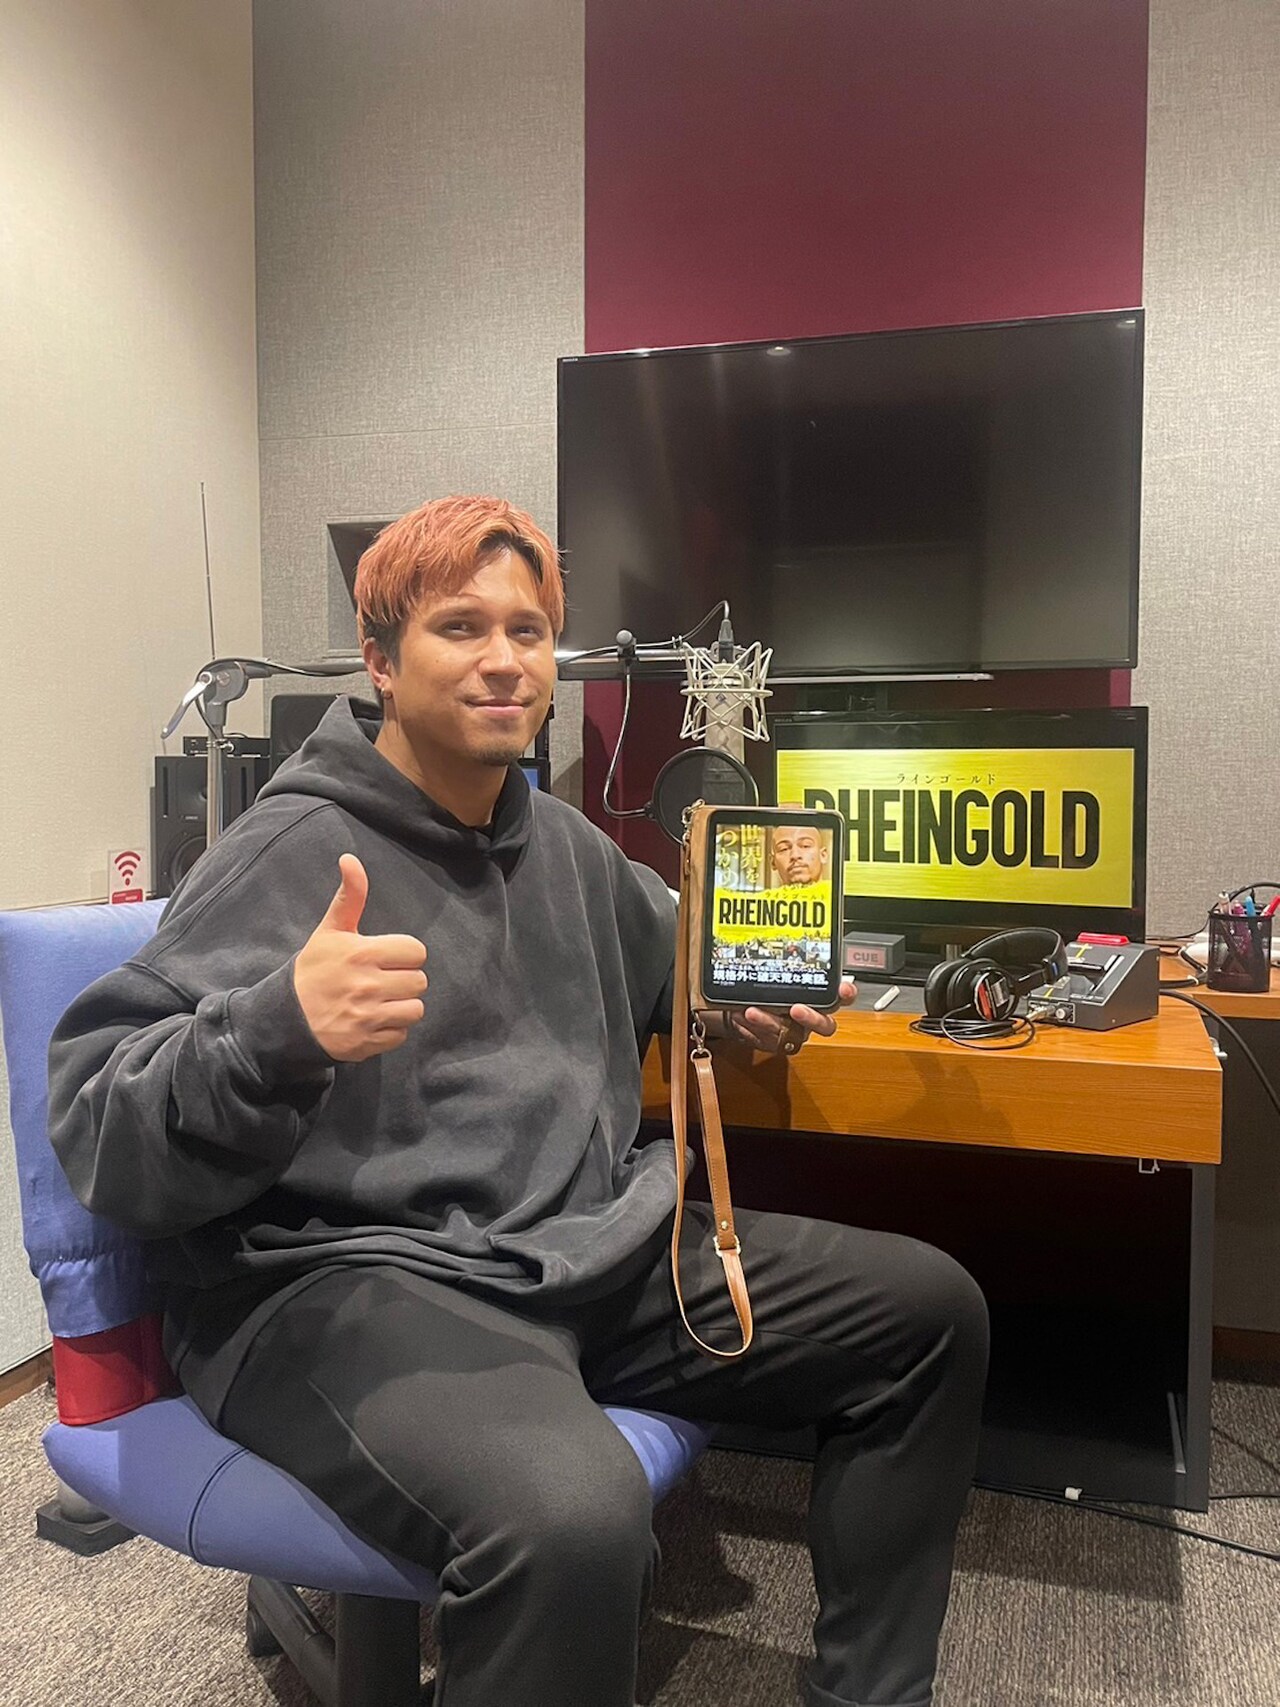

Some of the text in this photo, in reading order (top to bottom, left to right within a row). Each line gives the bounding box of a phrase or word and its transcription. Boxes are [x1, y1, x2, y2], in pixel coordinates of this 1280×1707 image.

[896, 773, 997, 785] ラインゴールド
[804, 789, 1100, 869] HEINGOLD
[741, 824, 763, 883] 世界を
[719, 897, 826, 929] RHEINGOLD
[853, 952, 879, 963] CUE
